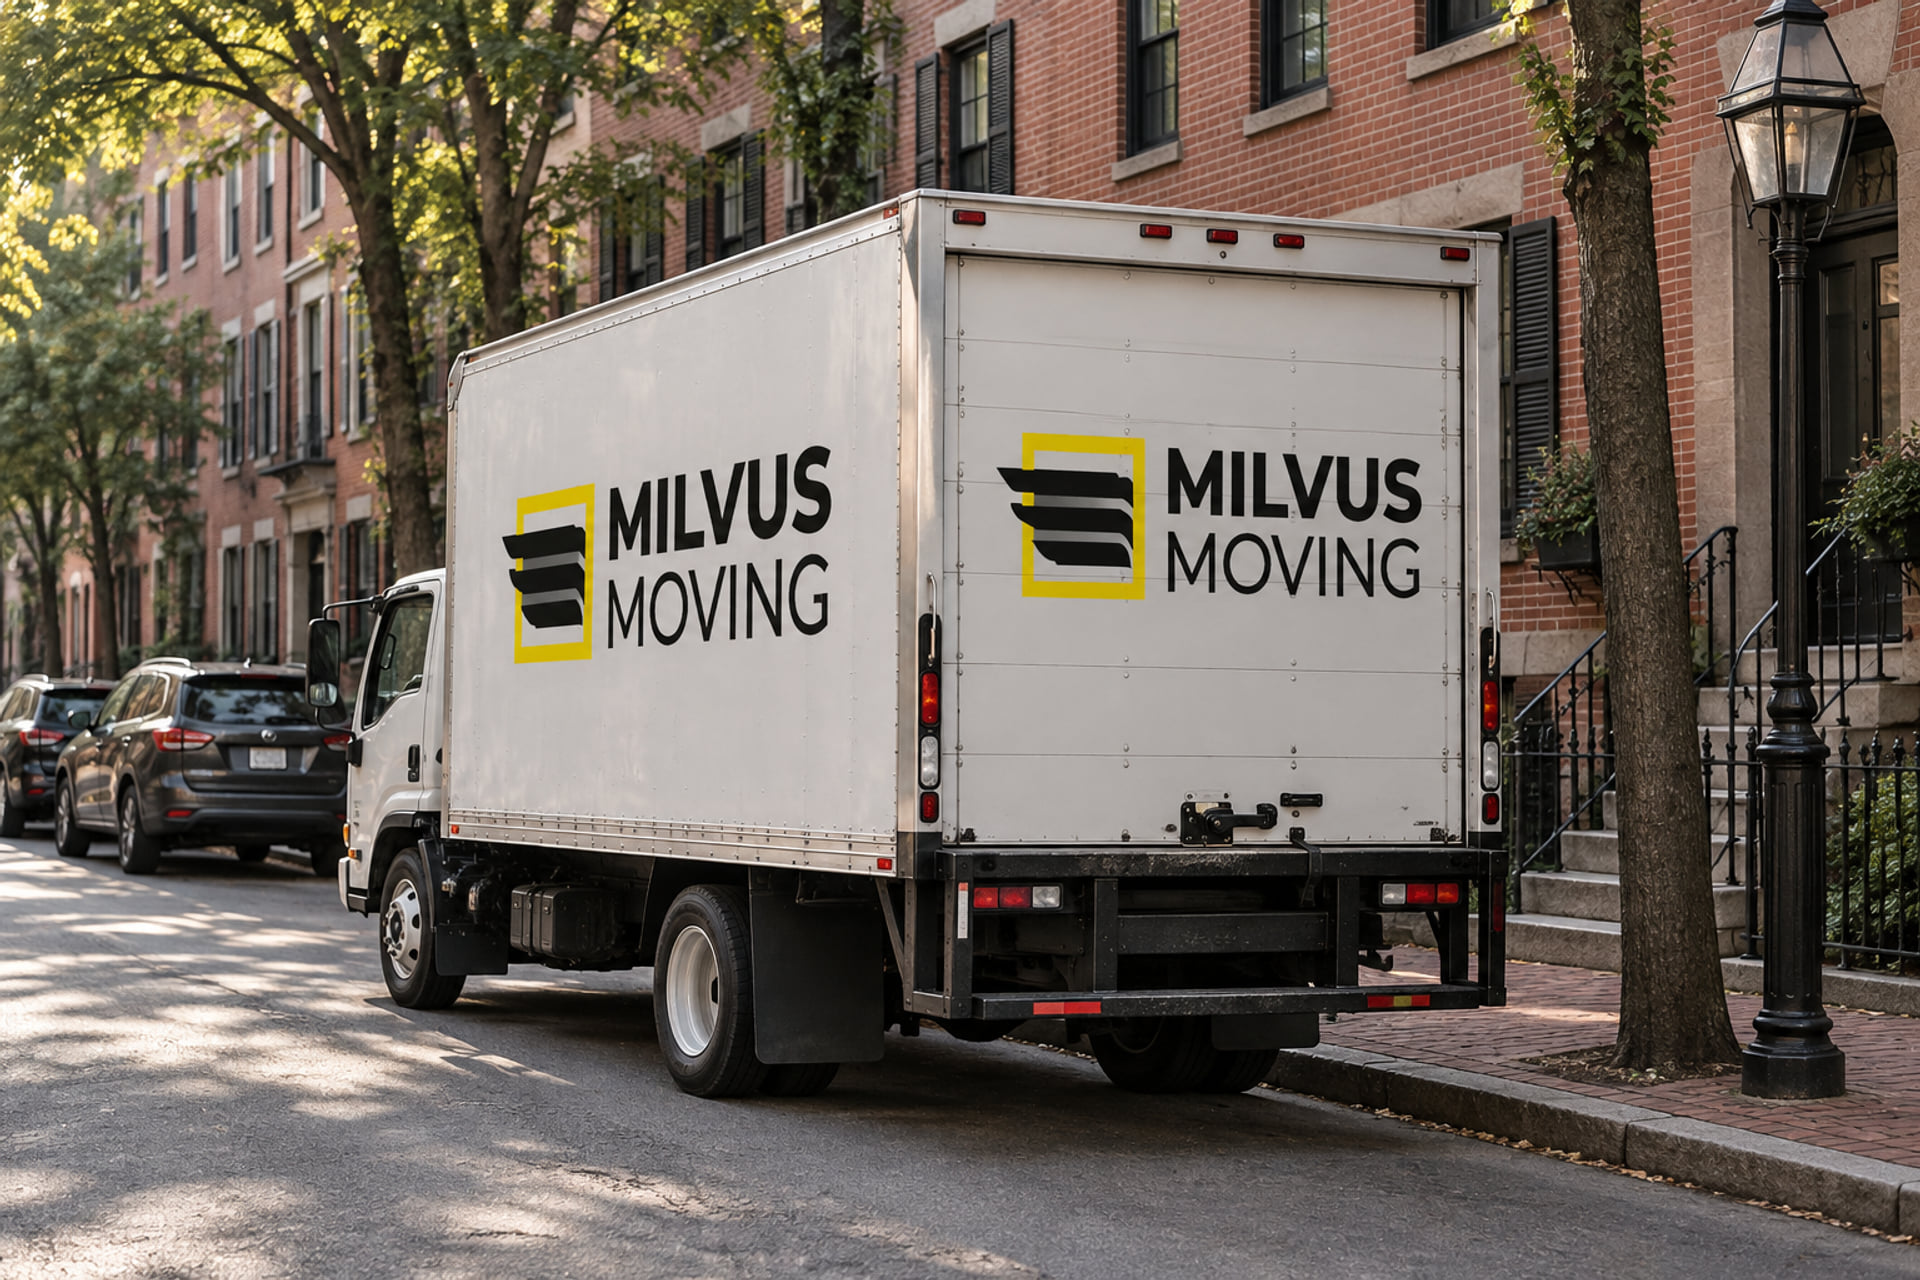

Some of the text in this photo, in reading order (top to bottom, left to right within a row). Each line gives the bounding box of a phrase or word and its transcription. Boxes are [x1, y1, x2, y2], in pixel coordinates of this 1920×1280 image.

[608, 445, 832, 561] MILVUS
[1167, 447, 1423, 524] MILVUS
[607, 553, 829, 649] MOVING
[1167, 530, 1422, 599] MOVING
